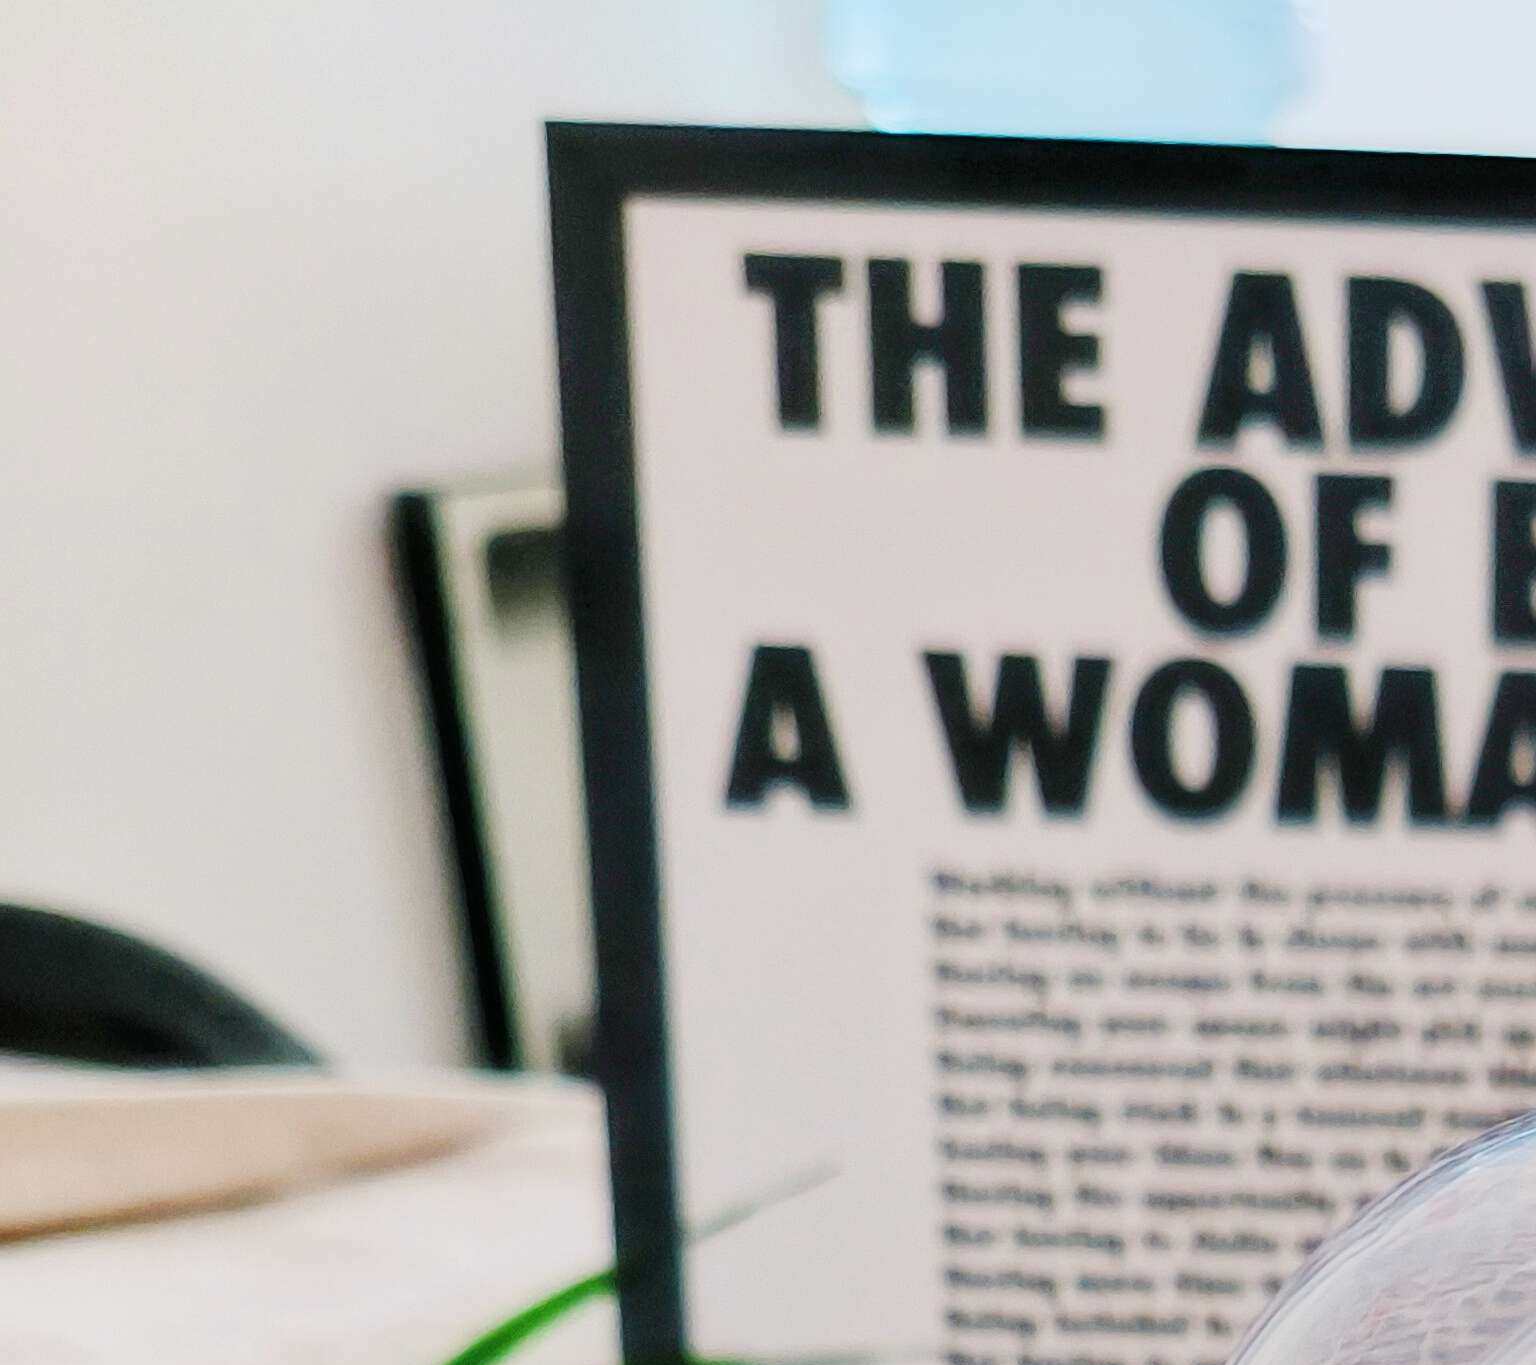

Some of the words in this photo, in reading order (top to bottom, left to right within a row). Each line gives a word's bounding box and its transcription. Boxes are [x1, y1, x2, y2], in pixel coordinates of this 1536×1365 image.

[740, 250, 1109, 444] THE
[1155, 462, 1398, 648] OF
[721, 641, 853, 815] A
